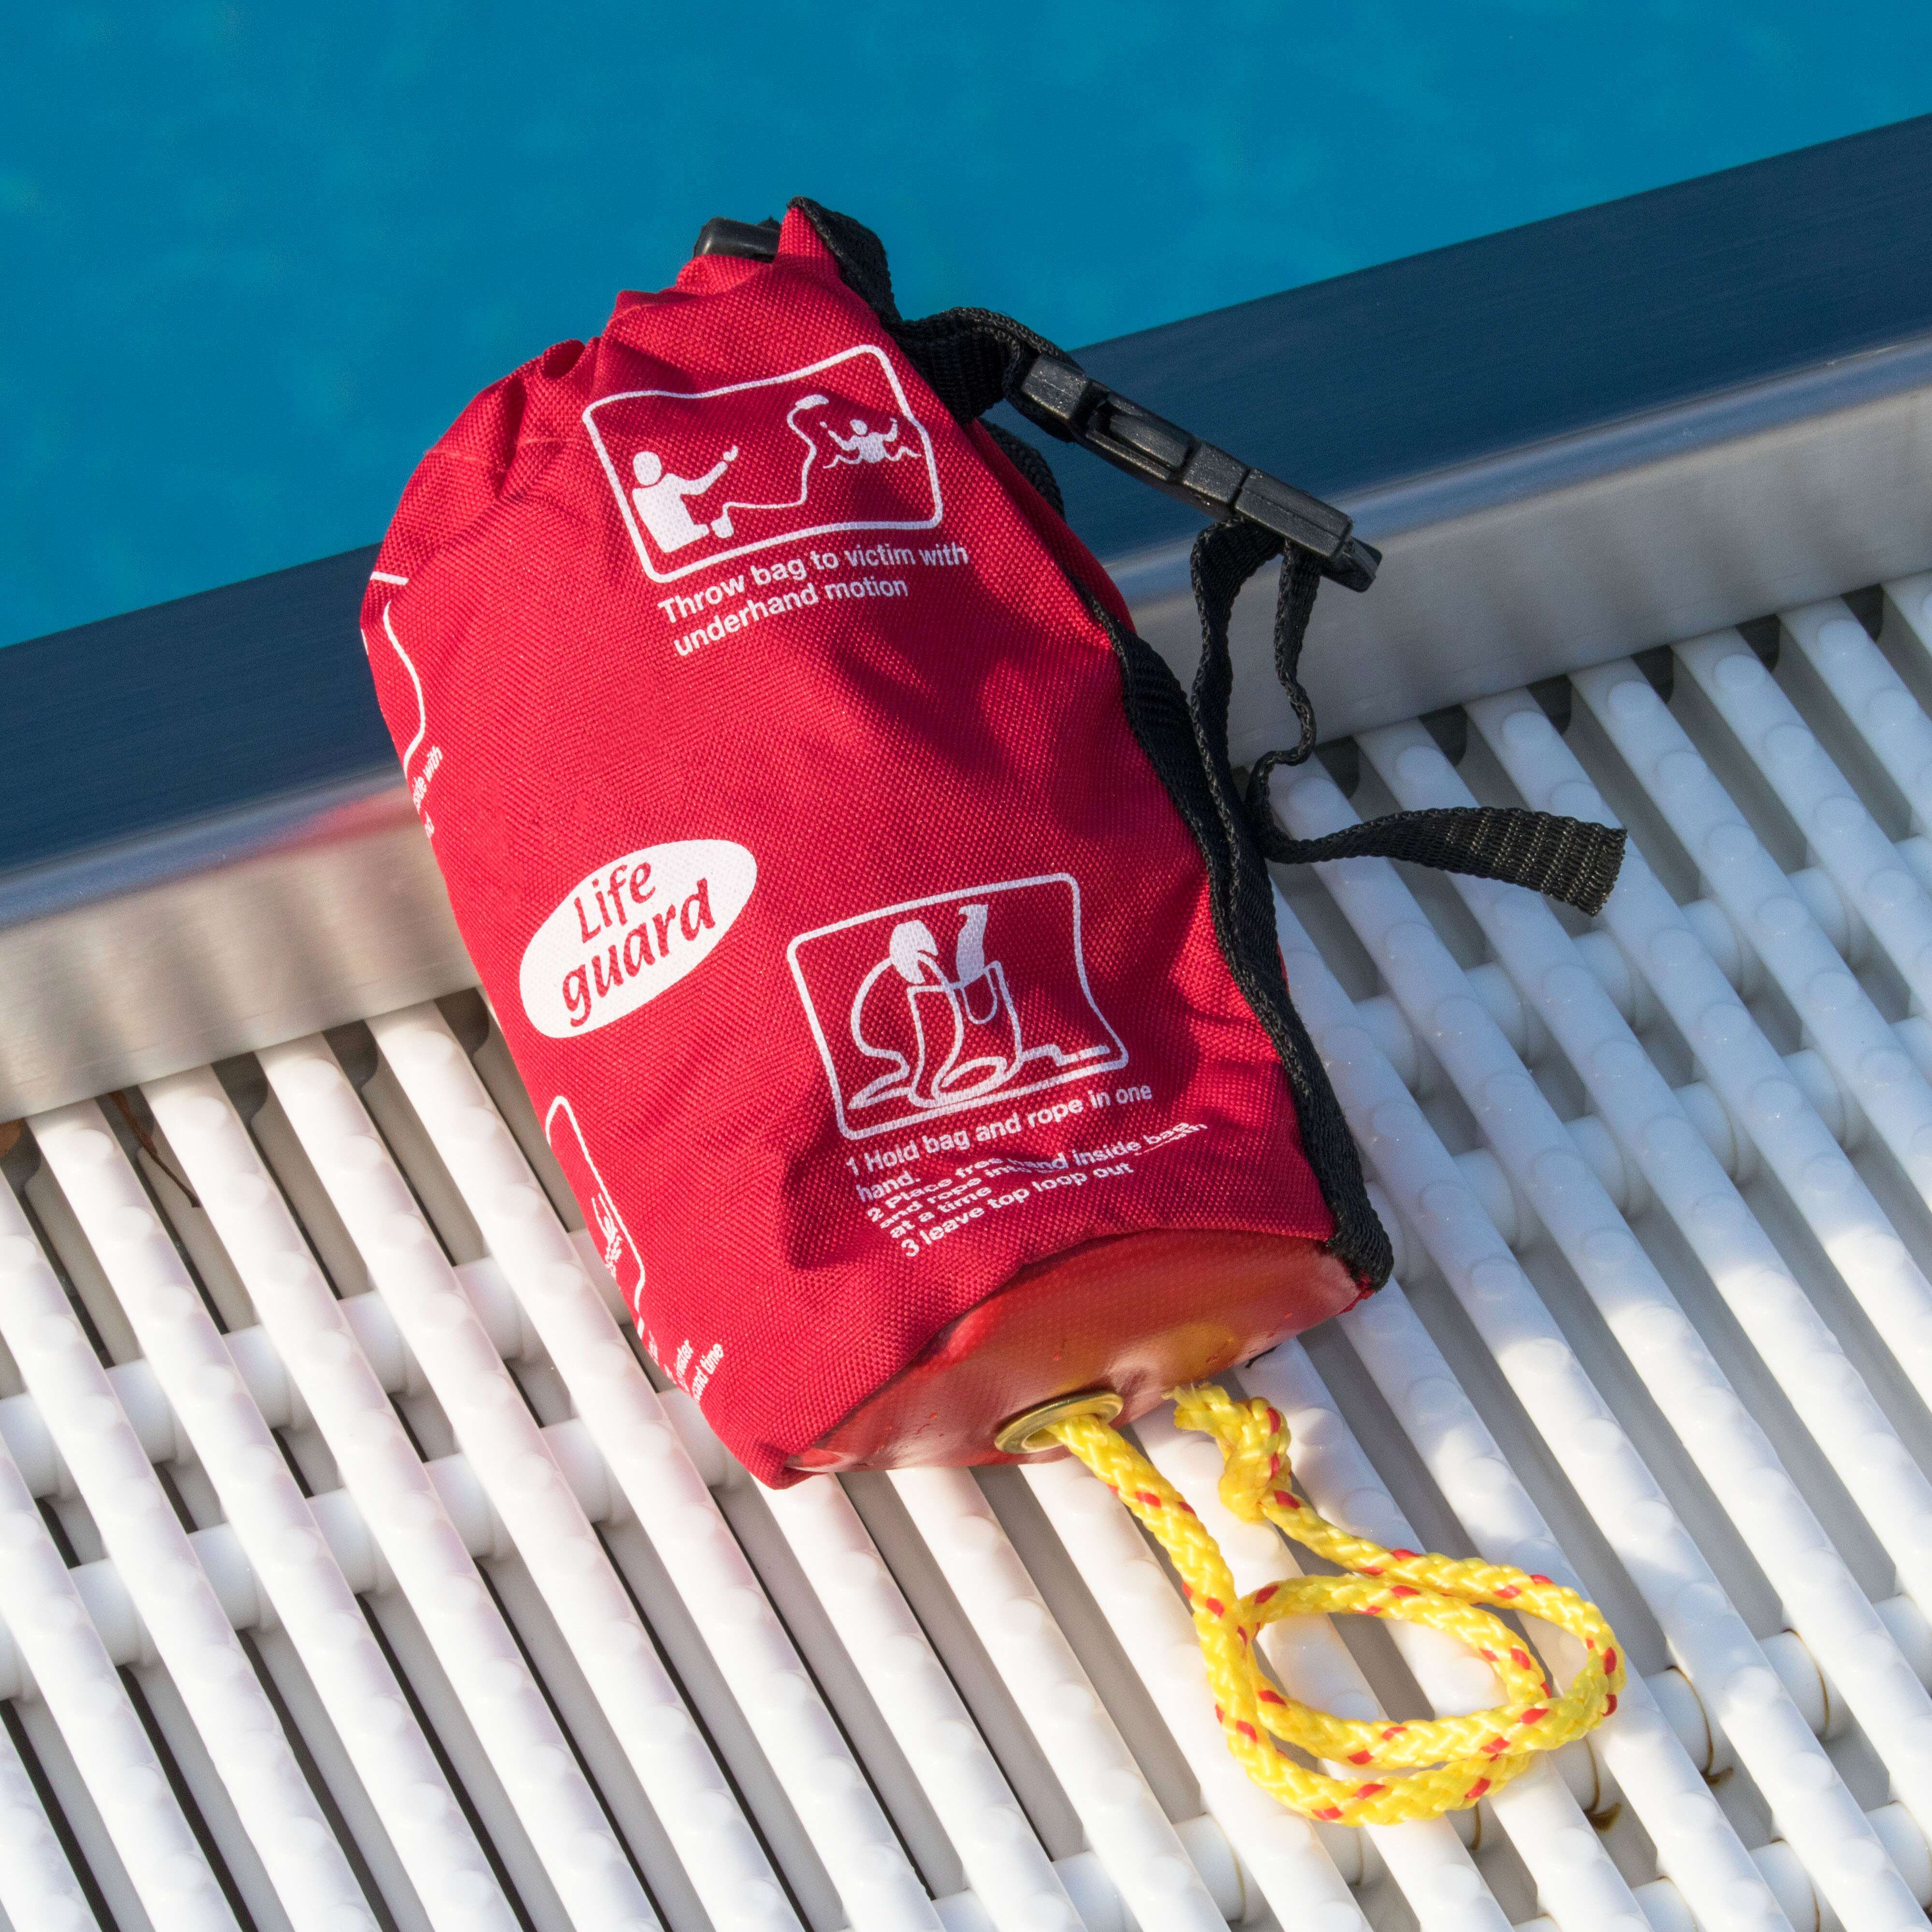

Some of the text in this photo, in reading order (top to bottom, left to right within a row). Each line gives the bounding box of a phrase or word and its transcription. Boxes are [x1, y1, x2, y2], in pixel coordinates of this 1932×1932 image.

[657, 542, 968, 624] Throw bag to victim with
[674, 576, 909, 656] underhand motion
[574, 862, 655, 943] Life
[562, 877, 716, 1027] guard
[846, 1085, 1152, 1176] 1 Hold bag and rope in one
[856, 1170, 921, 1202] hand.
[867, 1207, 884, 1222] 2
[885, 1179, 952, 1208] Place
[955, 1158, 1003, 1178] free
[1072, 1141, 1141, 1166] inside
[880, 1201, 923, 1228] and
[927, 1178, 981, 1204] rope
[890, 1187, 992, 1238] at a time
[901, 1163, 1134, 1257] 3 leave top loop out
